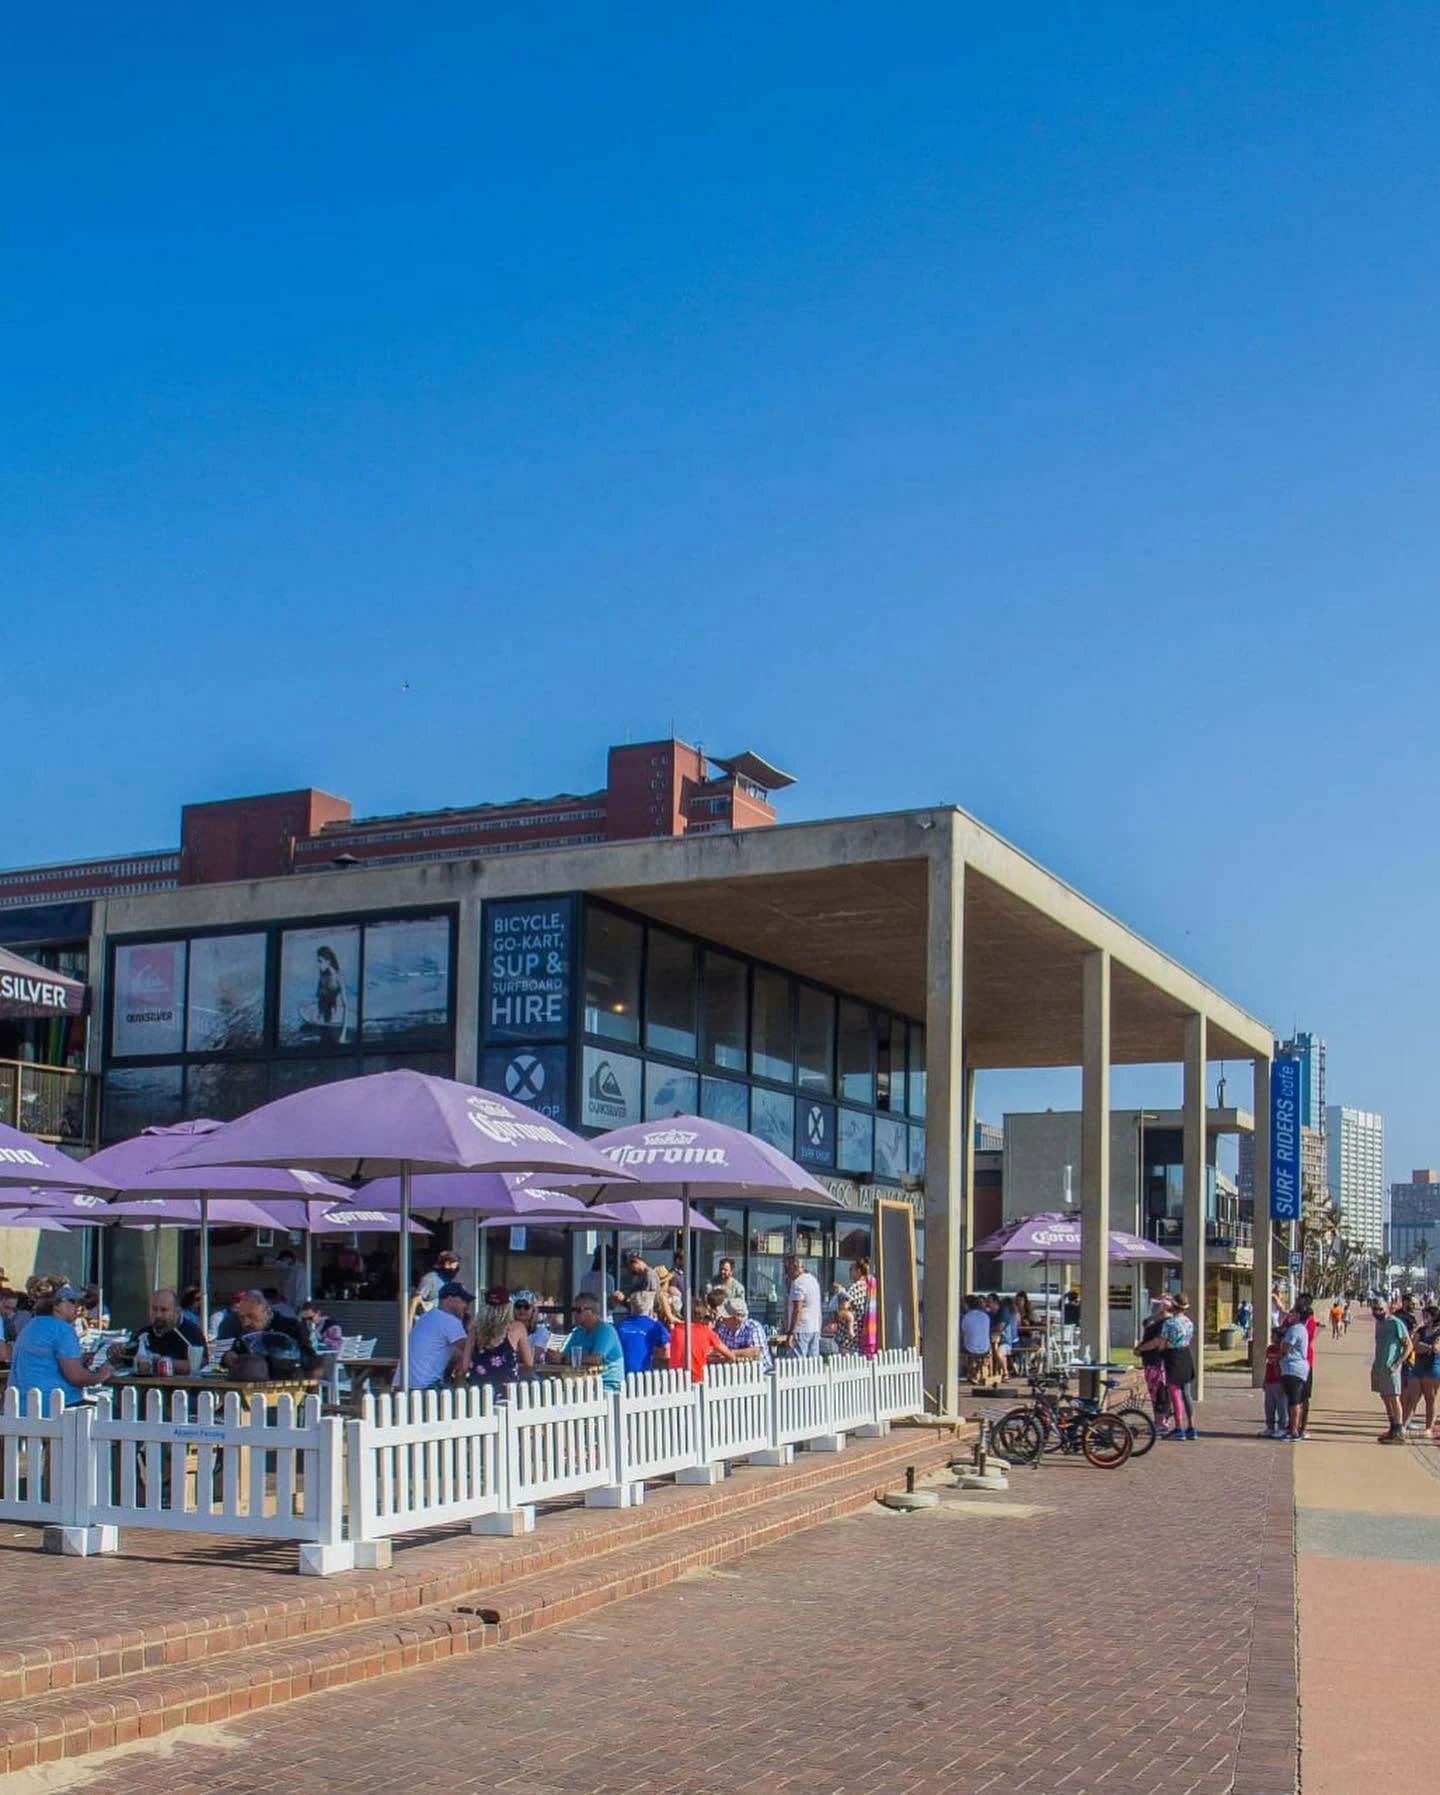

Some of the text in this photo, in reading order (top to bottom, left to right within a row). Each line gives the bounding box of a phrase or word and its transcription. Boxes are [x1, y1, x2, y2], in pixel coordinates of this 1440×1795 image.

[494, 912, 565, 934] BICYCLE,
[494, 933, 564, 951] GO-KART,
[493, 951, 562, 978] SUP &
[0, 975, 67, 1009] SILVER
[492, 978, 562, 994] SURFBOARD
[491, 994, 562, 1025] HIRE
[468, 1111, 569, 1147] Corona
[1276, 1098, 1294, 1162] RIDERS
[601, 1144, 728, 1167] Corona
[1276, 1166, 1294, 1217] SURF
